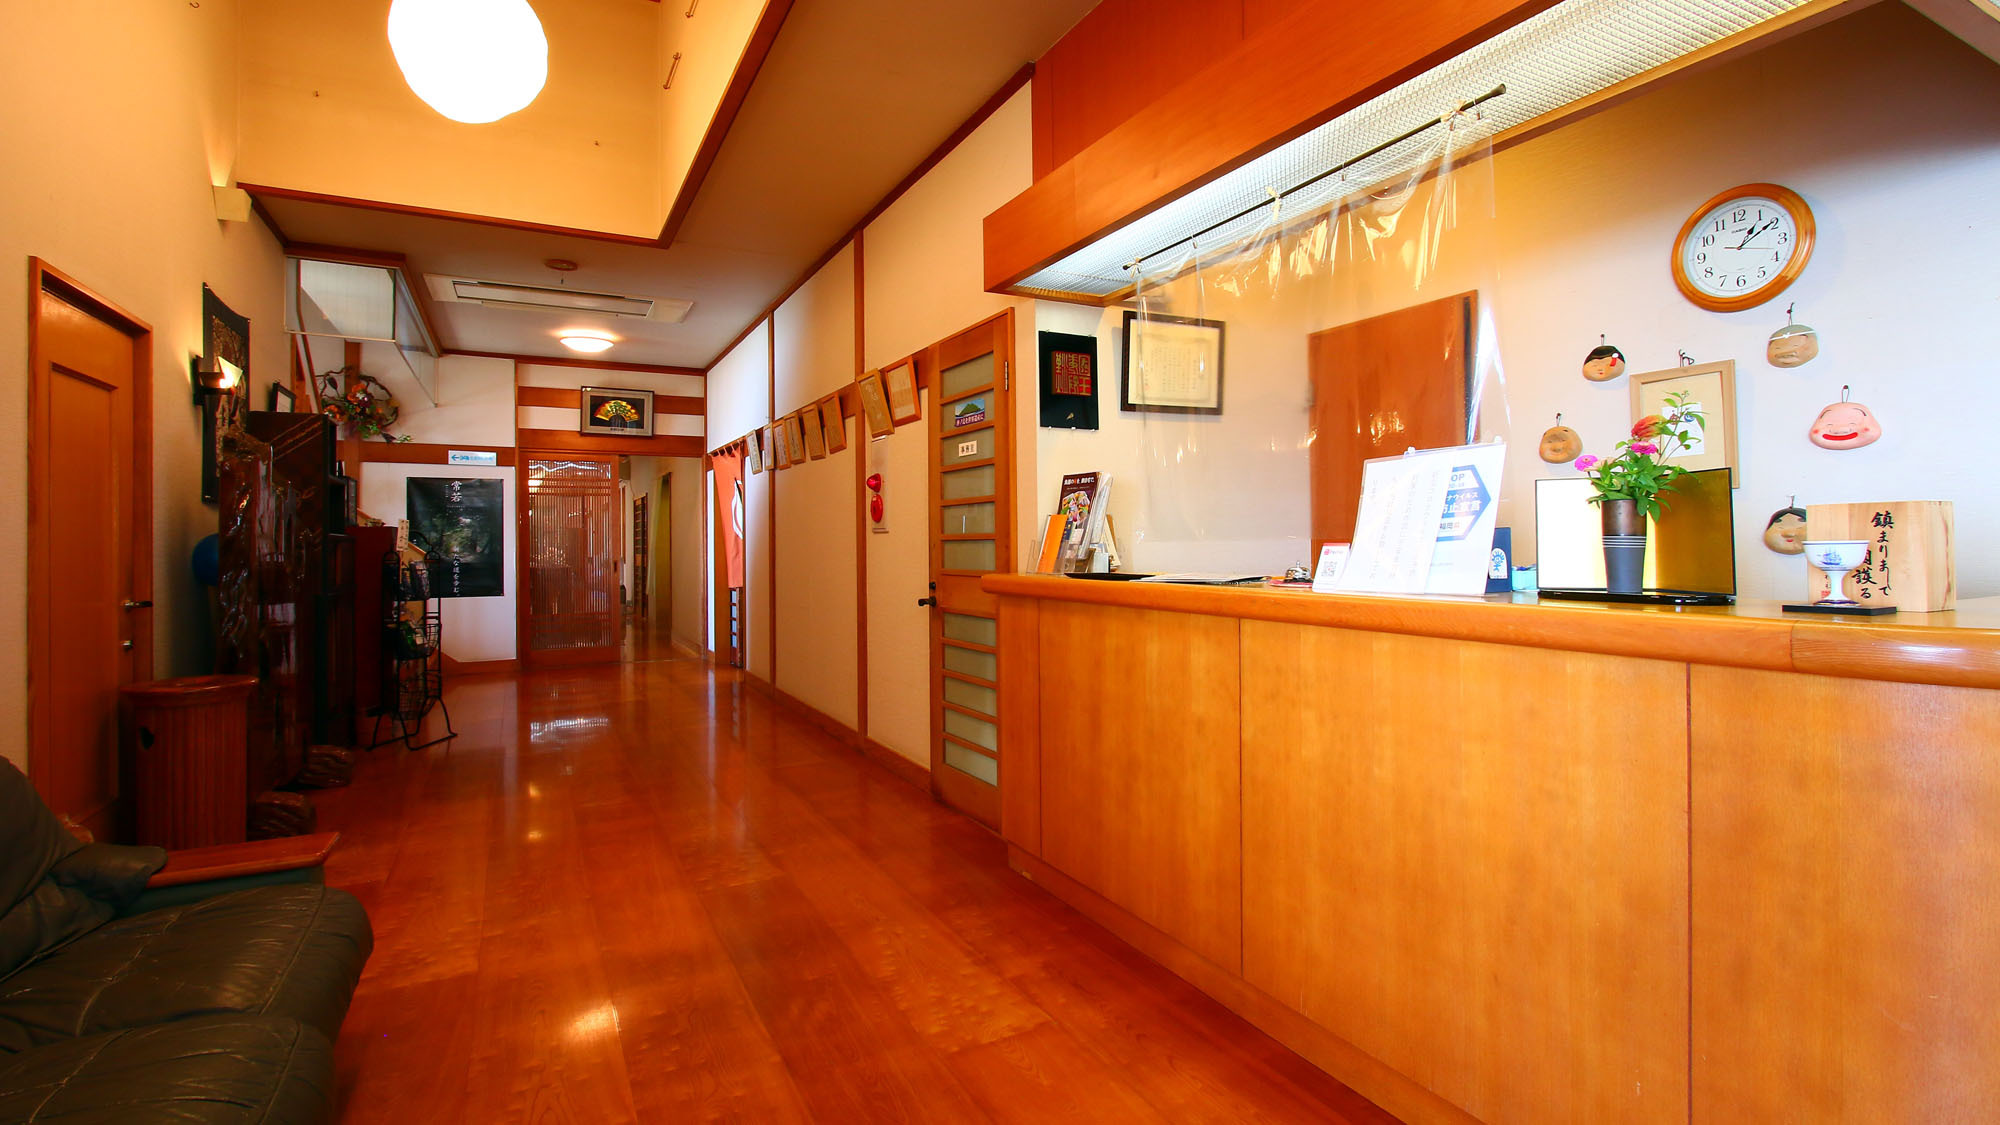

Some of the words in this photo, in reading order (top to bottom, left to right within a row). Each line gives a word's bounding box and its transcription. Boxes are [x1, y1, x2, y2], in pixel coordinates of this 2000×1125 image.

[1732, 208, 1746, 224] 12
[1757, 209, 1763, 221] 1
[1714, 219, 1727, 232] 11
[1770, 217, 1779, 231] 2
[1702, 234, 1715, 248] 10
[1777, 232, 1788, 245] 3
[1696, 252, 1706, 265] 9
[1770, 250, 1780, 262] 4
[1704, 266, 1714, 279] 8
[1757, 266, 1766, 279] 5
[1718, 275, 1727, 288] 7
[1736, 275, 1747, 288] 6
[1451, 473, 1465, 482] OP
[450, 480, 463, 503] 常若
[1446, 491, 1478, 501] ナウイルス
[1870, 510, 1895, 596] 鎮まりまして
